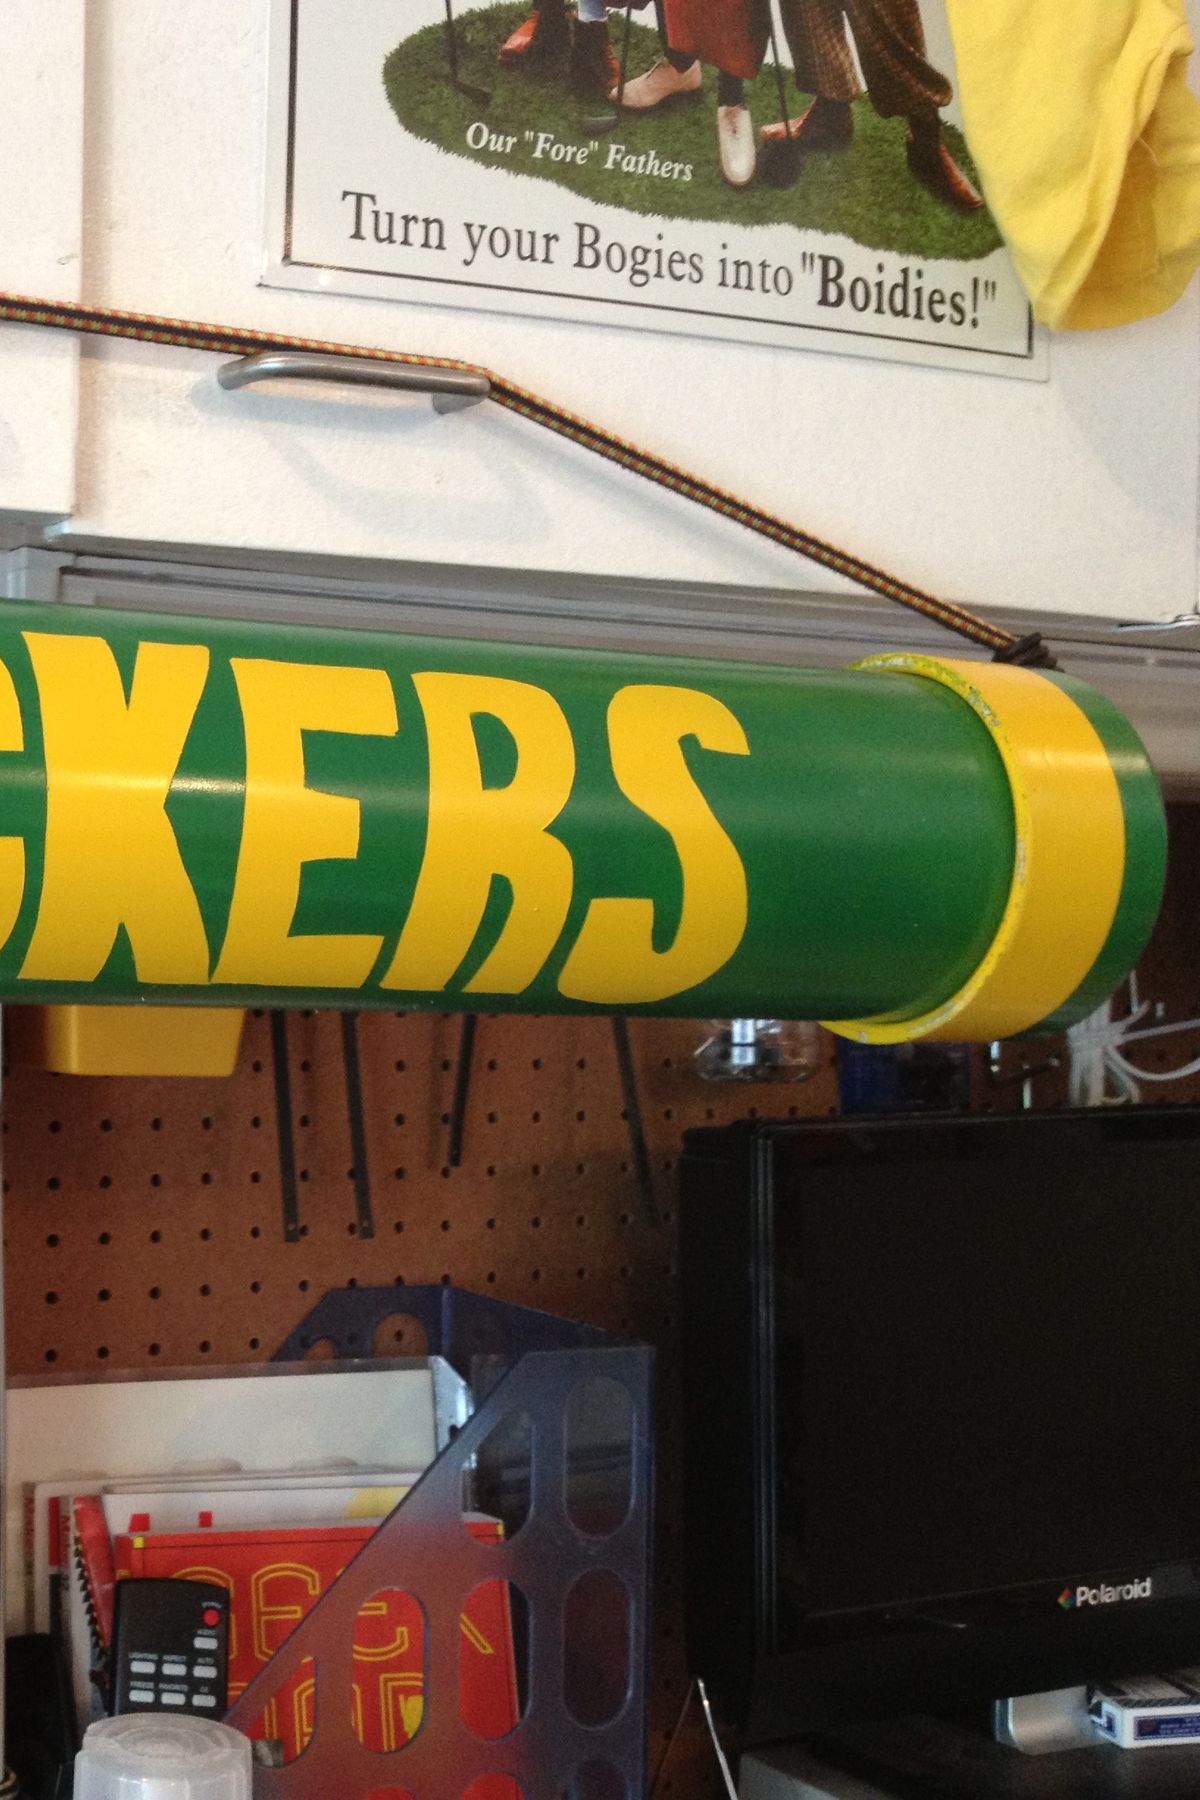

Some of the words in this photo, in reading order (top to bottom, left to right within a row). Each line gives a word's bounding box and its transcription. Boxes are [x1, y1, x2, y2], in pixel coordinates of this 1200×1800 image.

[466, 121, 518, 156] Our
[523, 130, 599, 168] "Fore"
[604, 142, 694, 182] Fathers
[342, 190, 445, 251] Turn
[463, 221, 560, 267] your
[572, 222, 704, 287] Bogies
[718, 244, 794, 296] into
[801, 253, 997, 328] "Boidies!"
[1075, 1577, 1152, 1608] Polaroid
